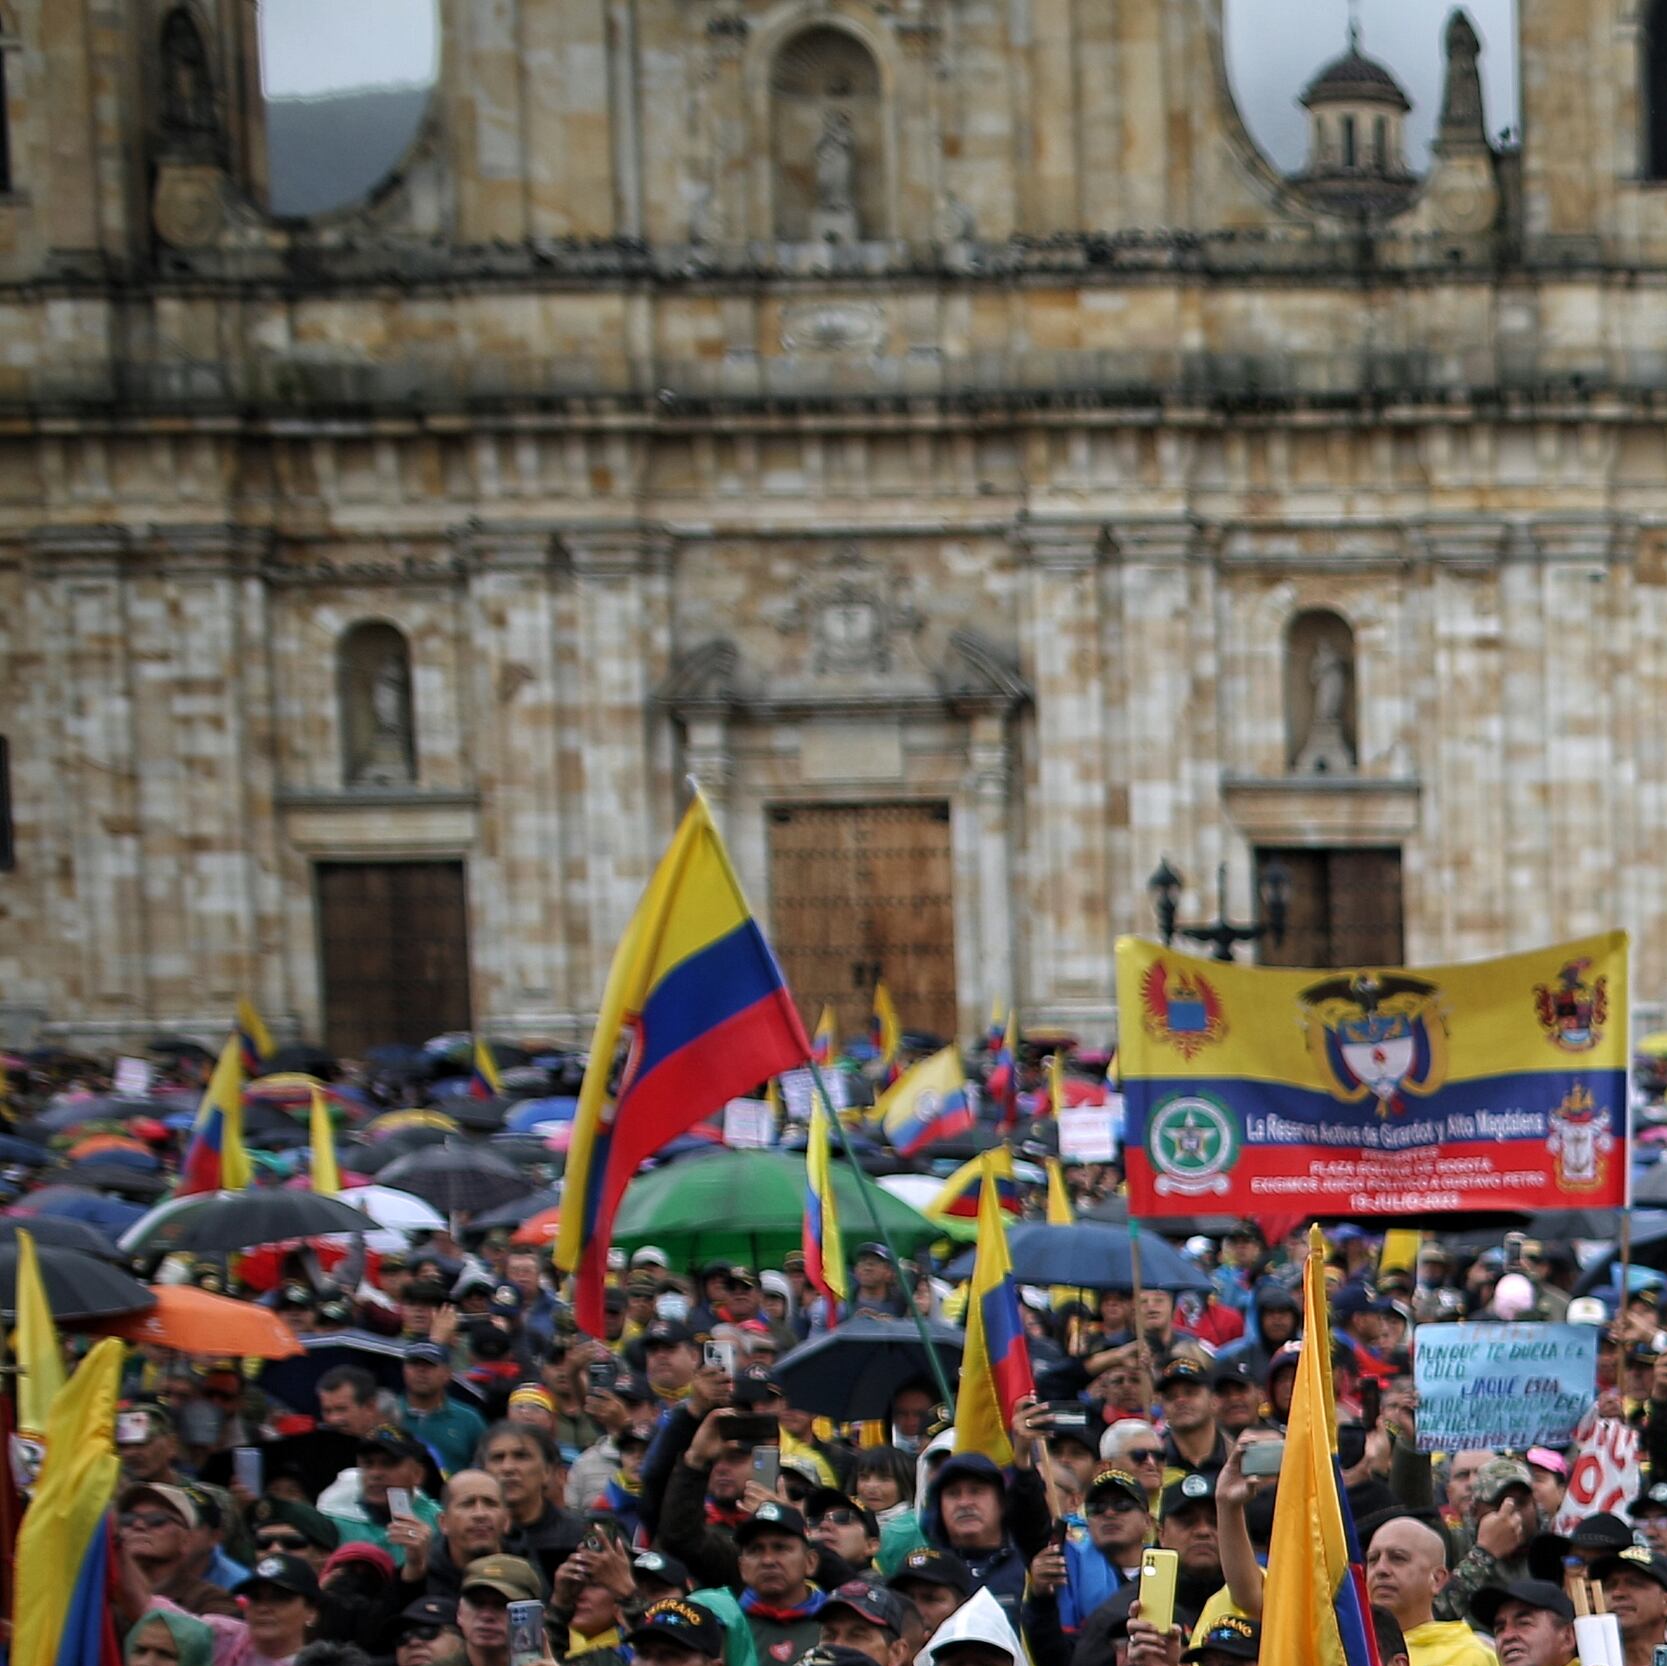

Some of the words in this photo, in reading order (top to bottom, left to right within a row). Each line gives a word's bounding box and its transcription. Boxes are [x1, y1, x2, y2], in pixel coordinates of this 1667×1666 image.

[1246, 1112, 1266, 1142] La
[1446, 1111, 1476, 1140] Alto
[1502, 1170, 1547, 1189] PETRO
[1416, 1342, 1480, 1363] AUNQUE
[1486, 1342, 1503, 1361] TE
